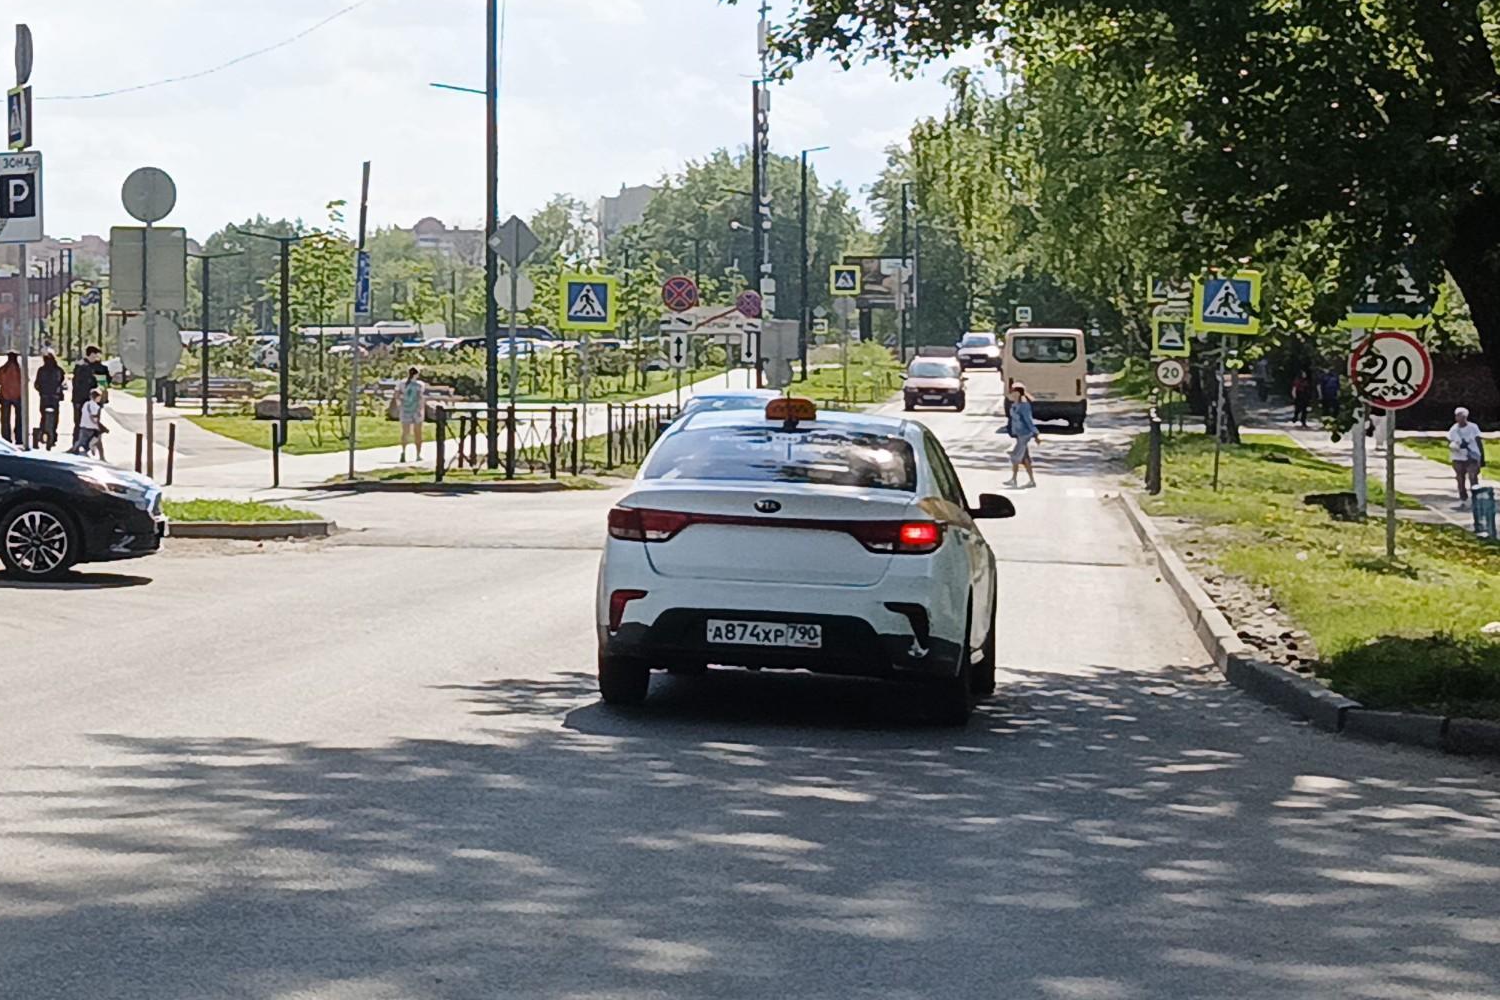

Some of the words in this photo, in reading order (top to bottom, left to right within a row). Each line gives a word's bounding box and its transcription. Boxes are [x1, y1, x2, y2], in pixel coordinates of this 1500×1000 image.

[8, 179, 30, 214] P
[1162, 366, 1180, 379] 20
[1366, 354, 1412, 385] 20
